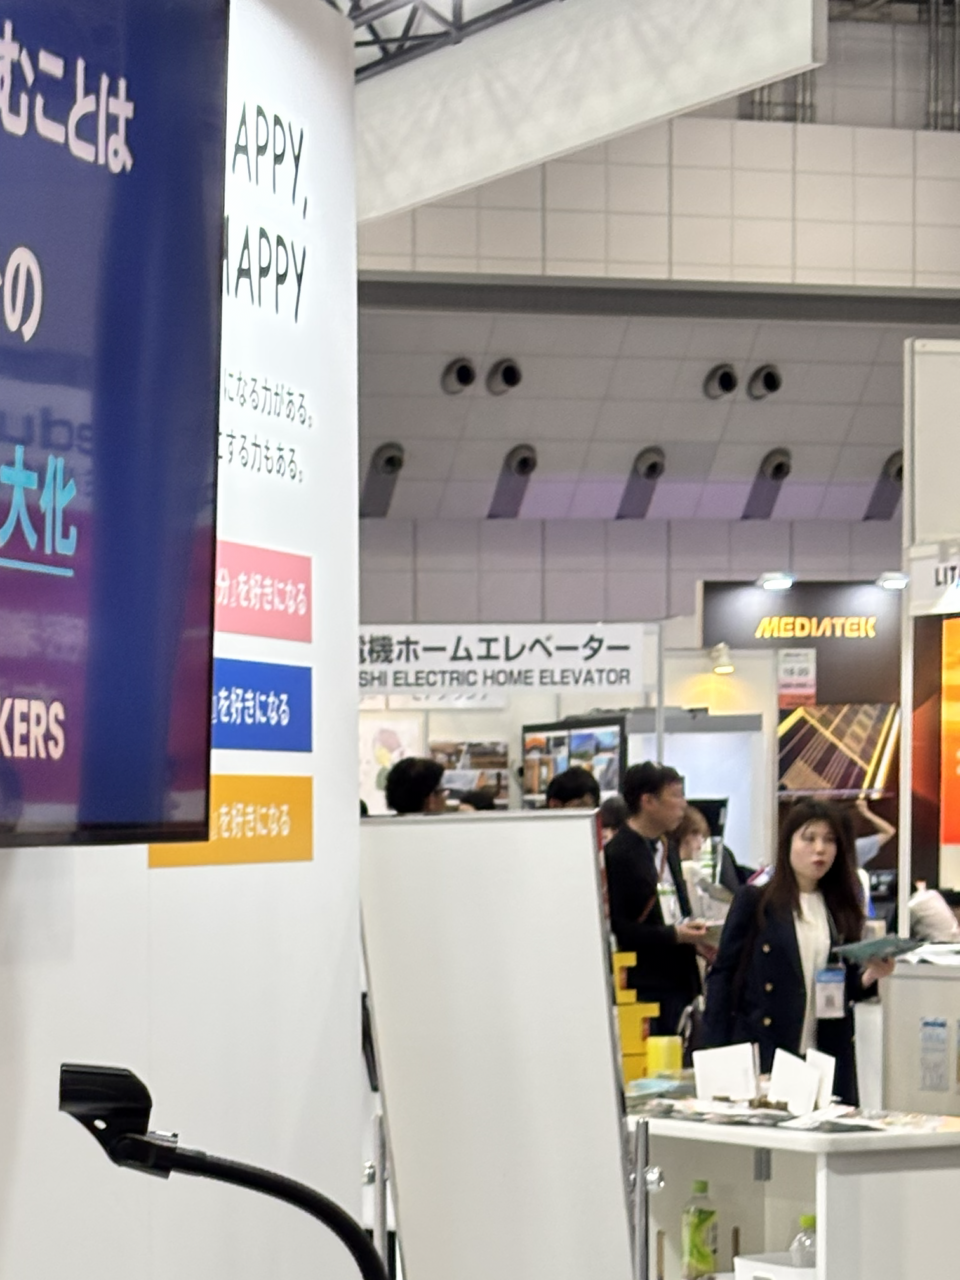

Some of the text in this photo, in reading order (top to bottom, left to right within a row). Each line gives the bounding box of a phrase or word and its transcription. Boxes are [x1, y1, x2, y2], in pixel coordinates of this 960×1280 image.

[755, 616, 877, 639] MEDIATEK
[359, 634, 631, 664] 機ホームエレベーター
[393, 670, 478, 687] ELECTRIC
[483, 669, 534, 687] HOME
[540, 668, 631, 686] ELEVATOR
